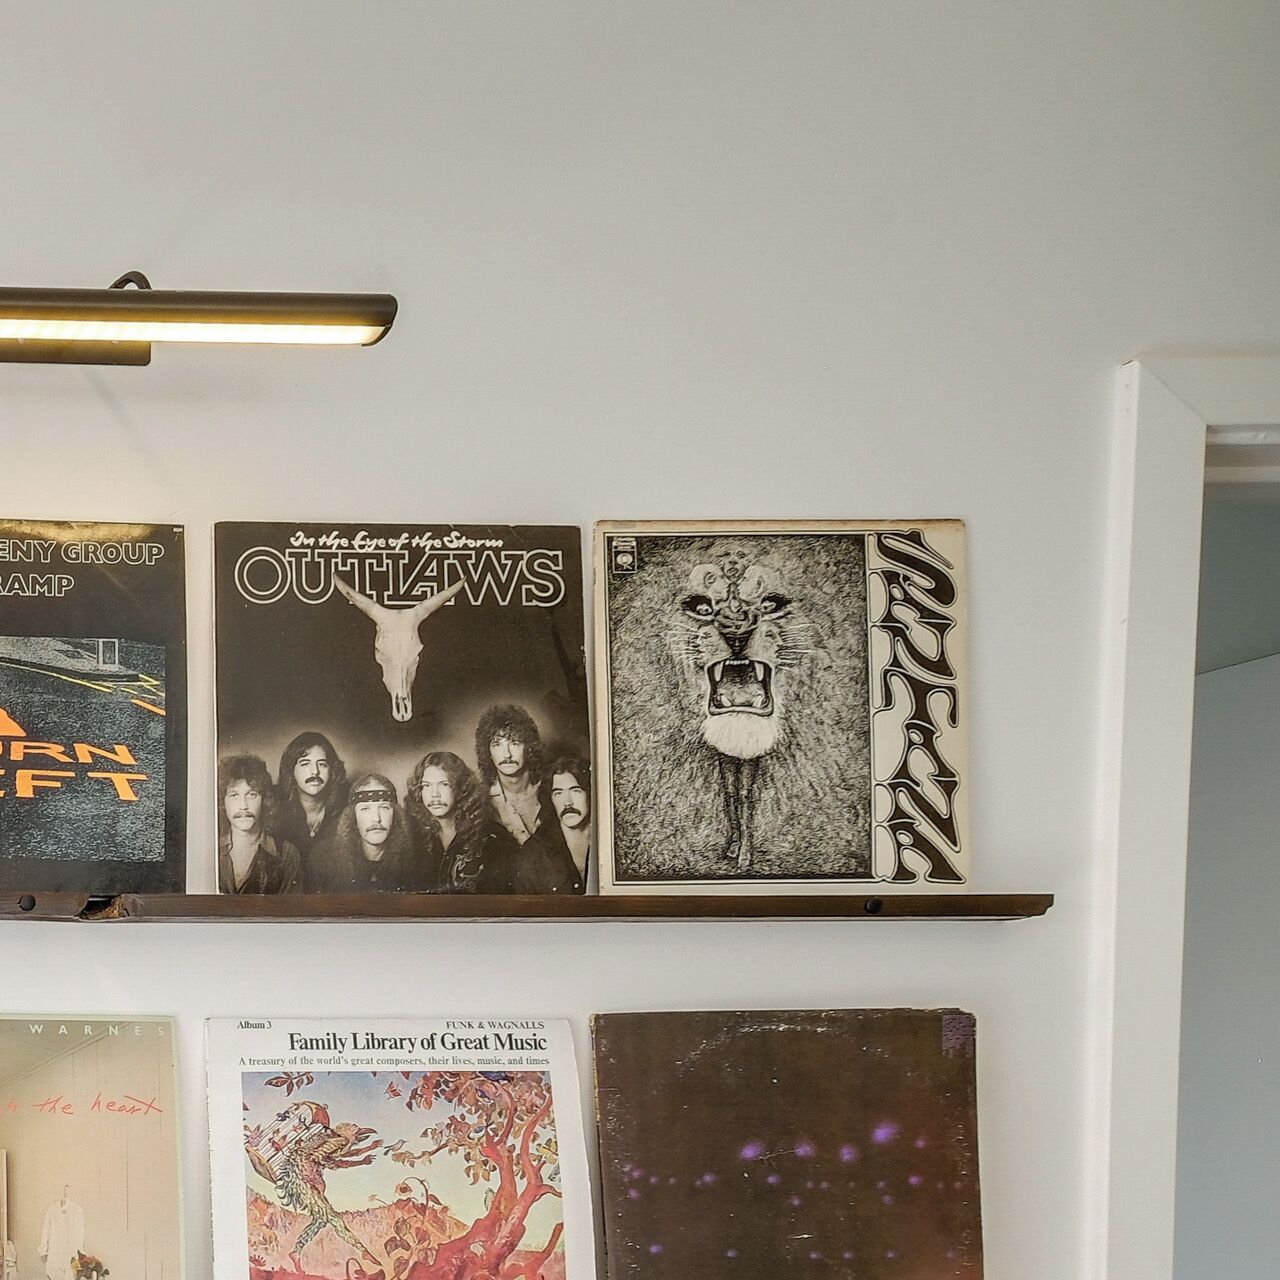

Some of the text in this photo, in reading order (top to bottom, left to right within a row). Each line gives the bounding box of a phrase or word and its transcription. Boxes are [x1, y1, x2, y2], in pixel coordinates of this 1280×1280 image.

[290, 530, 503, 552] In the Eye of the Storm
[61, 541, 165, 566] GROUP
[234, 546, 565, 607] OUTLAWS
[872, 529, 966, 884] SANTANA
[29, 1023, 165, 1037] WARNES
[237, 1020, 272, 1029] Album 3
[446, 1021, 545, 1030] FUNK & WAGNALLS
[287, 1032, 548, 1054] Family Library of Great Music
[238, 1056, 550, 1067] A treasury of the world's great composers, their lives, music, and times
[31, 1096, 75, 1115] the
[90, 1091, 163, 1116] heart
